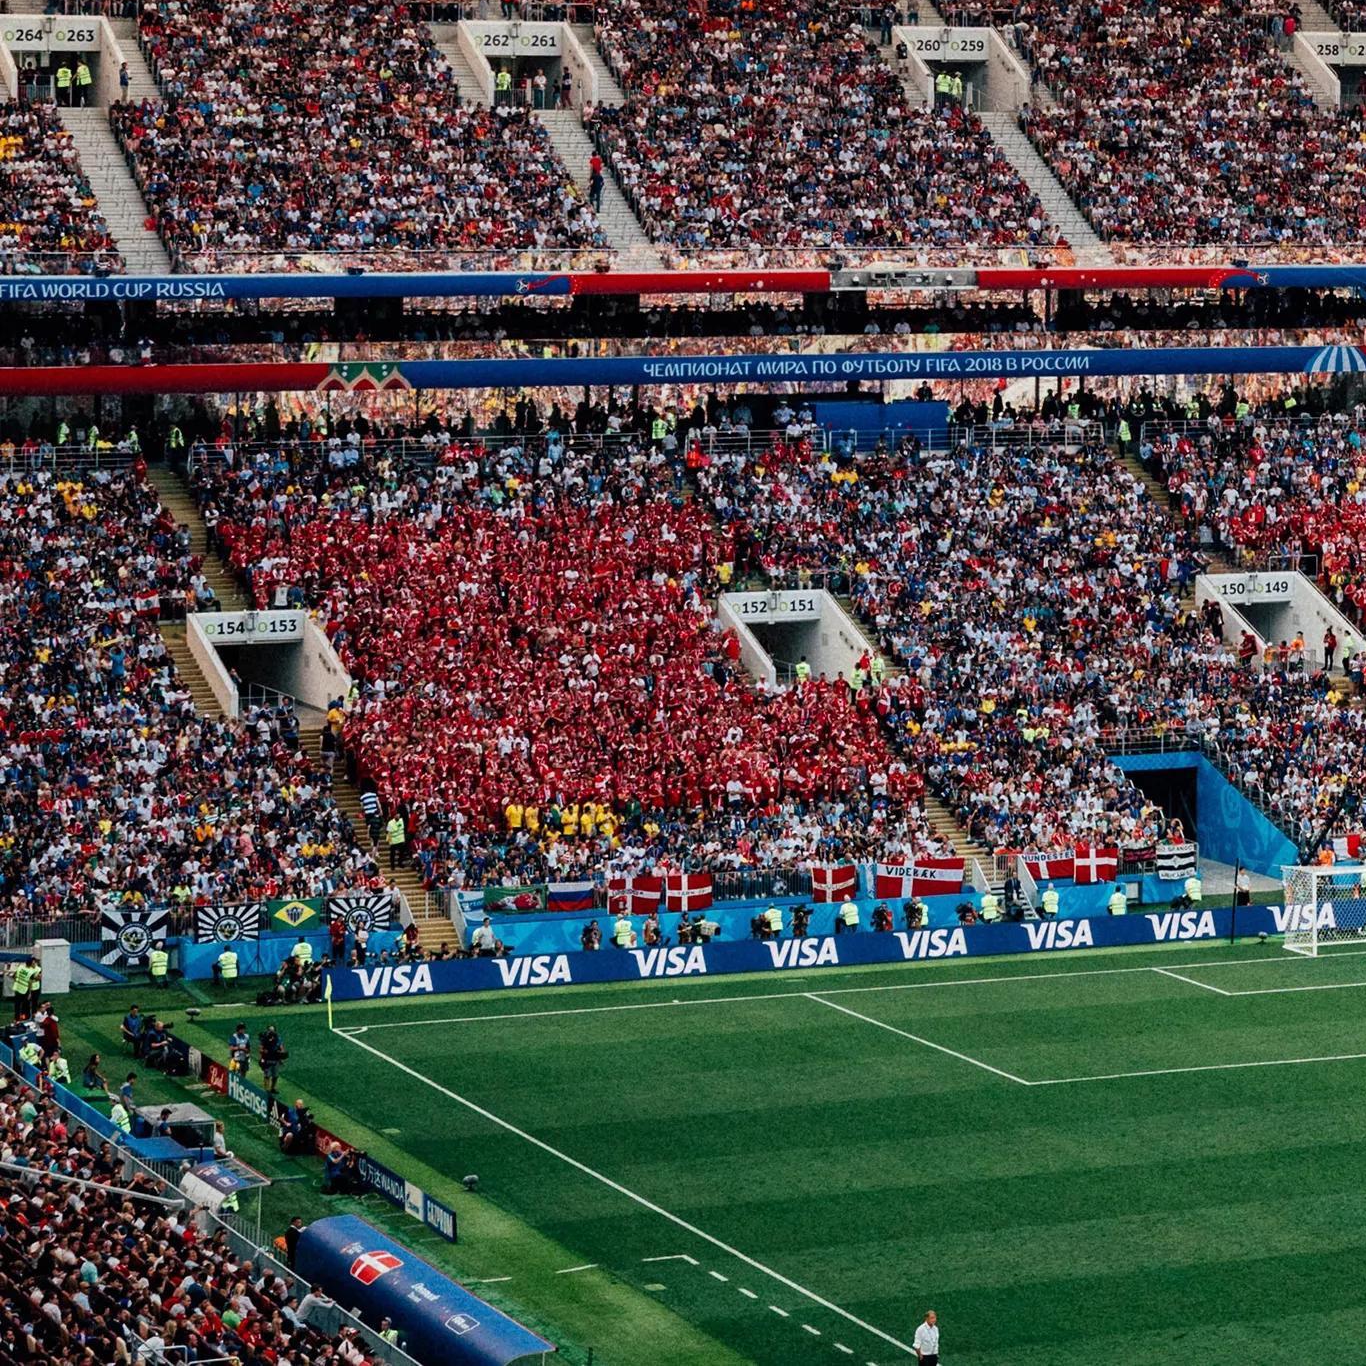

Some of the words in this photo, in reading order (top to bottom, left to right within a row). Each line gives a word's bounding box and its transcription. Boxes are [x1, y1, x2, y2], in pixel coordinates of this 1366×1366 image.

[15, 30, 44, 42] 264
[67, 30, 94, 42] 263
[484, 35, 509, 47] 262
[531, 35, 557, 47] 261
[916, 40, 940, 51] 260
[960, 41, 985, 52] 259
[1317, 44, 1340, 55] 258
[0, 283, 37, 298] FIFA
[41, 283, 109, 298] WORLD
[113, 282, 151, 297] CUP
[156, 282, 225, 297] RUSSIA
[643, 361, 751, 377] ЧЕМПИОНАТ
[757, 360, 807, 375] МИРА
[812, 360, 836, 374] ПО
[842, 359, 920, 374] ФУТБОЛУ
[926, 358, 960, 372] FIFA
[965, 358, 1001, 372] 2018
[1006, 357, 1017, 370] В
[1021, 356, 1089, 371] РОССИИ
[1221, 583, 1245, 595] 150
[1265, 581, 1288, 593] 149
[742, 601, 767, 613] 152
[790, 600, 815, 612] 151
[217, 622, 245, 634] 154
[269, 619, 297, 632] 153
[886, 866, 937, 879] VIDEBÆK
[1266, 902, 1336, 933] VISA
[1145, 910, 1216, 940] VISA
[1021, 919, 1094, 950] VISA
[893, 928, 968, 959] VISA
[762, 937, 839, 968] VISA
[629, 946, 707, 976] VISA
[492, 954, 571, 987] VISA
[353, 964, 433, 996] VISA
[228, 1074, 268, 1119] Hisense
[381, 1172, 405, 1203] WANDA
